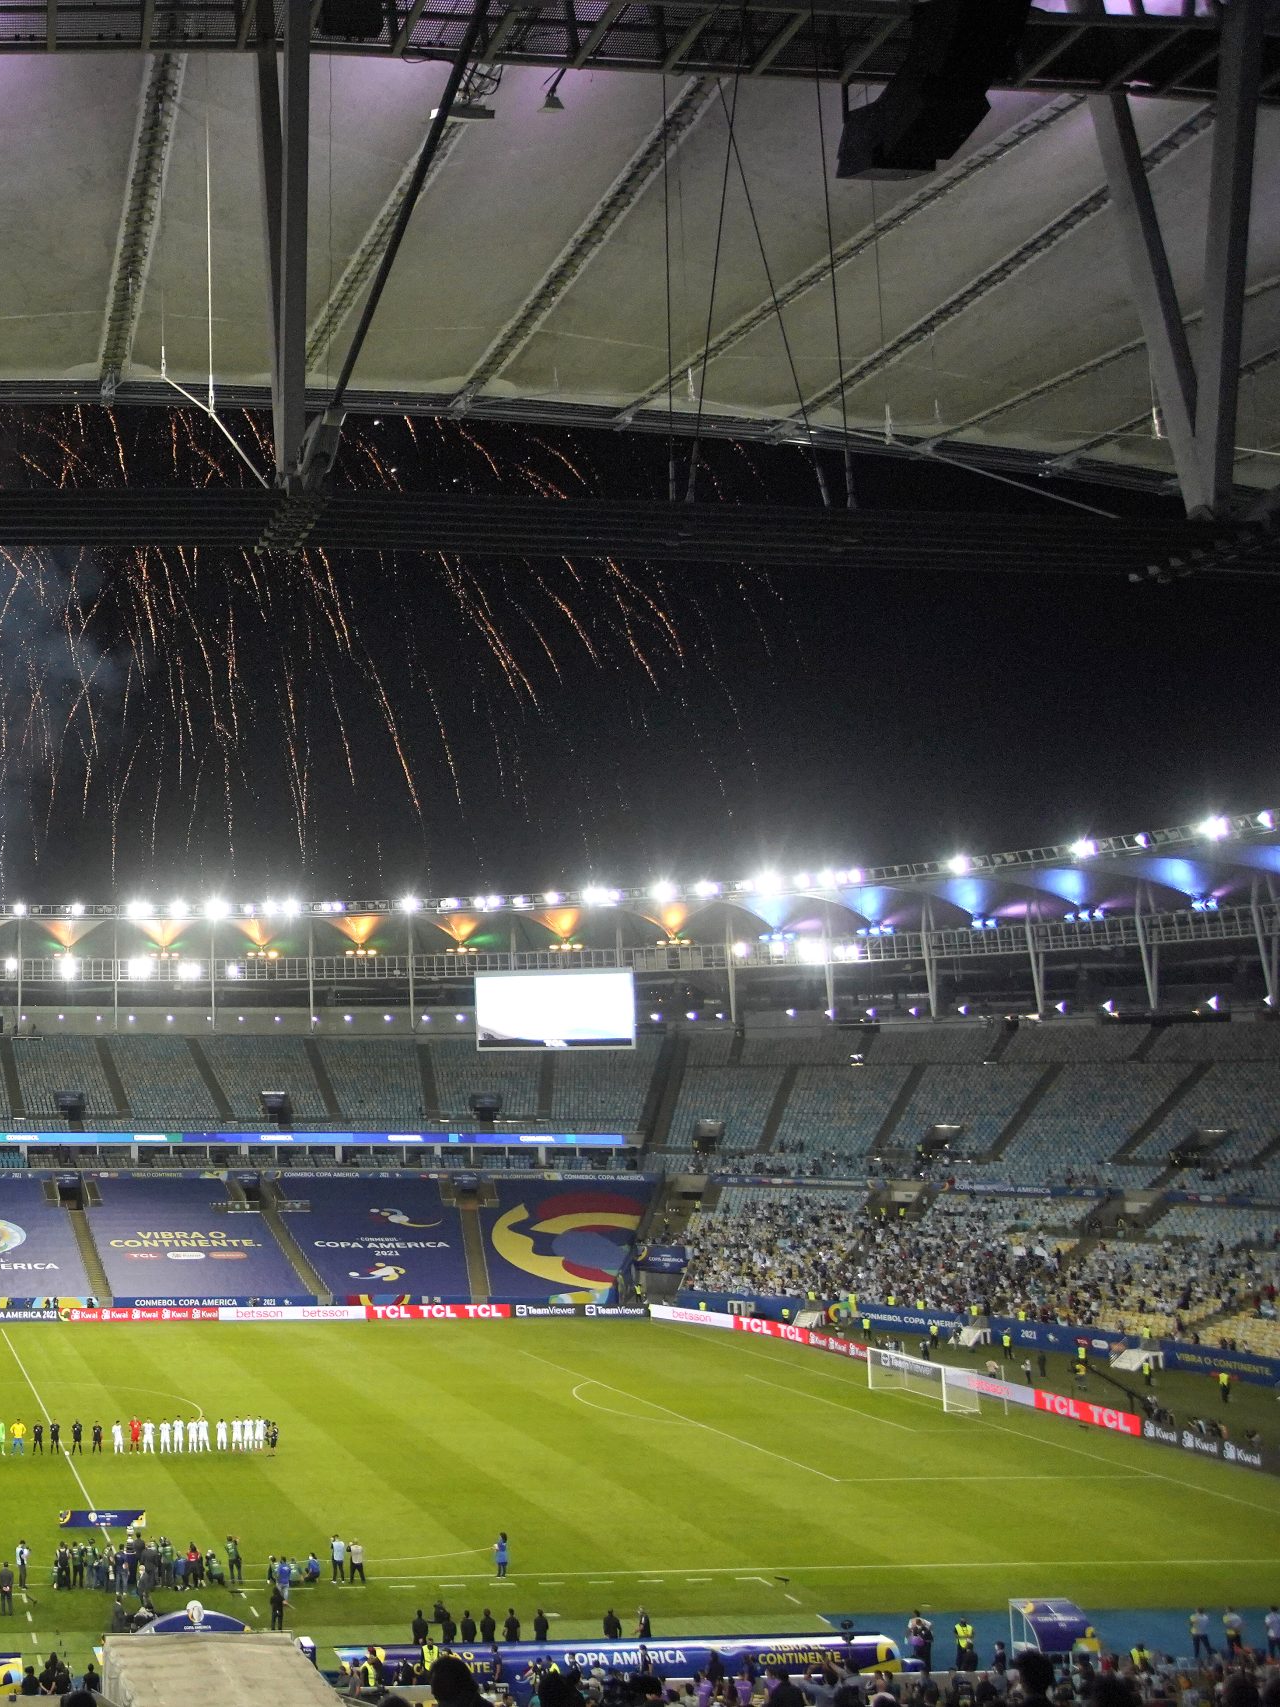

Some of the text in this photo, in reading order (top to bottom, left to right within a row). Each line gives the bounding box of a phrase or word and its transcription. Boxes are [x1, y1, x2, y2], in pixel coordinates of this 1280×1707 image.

[597, 1173, 615, 1181] COPA
[615, 1174, 645, 1182] AMERICA
[136, 1231, 226, 1239] VIBRA O
[109, 1239, 262, 1248] CONTINENTE.
[314, 1240, 451, 1249] COPA AMERICA
[134, 1299, 177, 1307] CONMEBOL
[178, 1299, 201, 1307] COPA
[6, 1310, 42, 1318] AMERICA
[42, 1310, 57, 1318] 2021
[111, 1311, 128, 1319] Kwai
[171, 1310, 188, 1318] Kwai
[201, 1310, 218, 1318] Kwai
[236, 1308, 283, 1318] betsson
[302, 1308, 349, 1318] betsson
[372, 1306, 411, 1318] TCL
[418, 1306, 457, 1318] TCL
[464, 1305, 502, 1317] TCL
[527, 1306, 576, 1315] TeamViewer
[597, 1305, 645, 1315] TeamViewer
[81, 1312, 98, 1320] Kwai
[672, 1309, 712, 1323] betsson
[860, 1311, 902, 1323] CONMEBOL
[903, 1316, 926, 1325] COPA
[738, 1318, 773, 1335] TCL
[777, 1324, 803, 1342] TCL
[1020, 1329, 1037, 1340] 2021
[1041, 1392, 1080, 1419] TCL
[1088, 1404, 1131, 1432] TCL
[1155, 1424, 1178, 1442] Kwai
[1194, 1435, 1217, 1454] Kwai
[1236, 1447, 1262, 1466] Kwai
